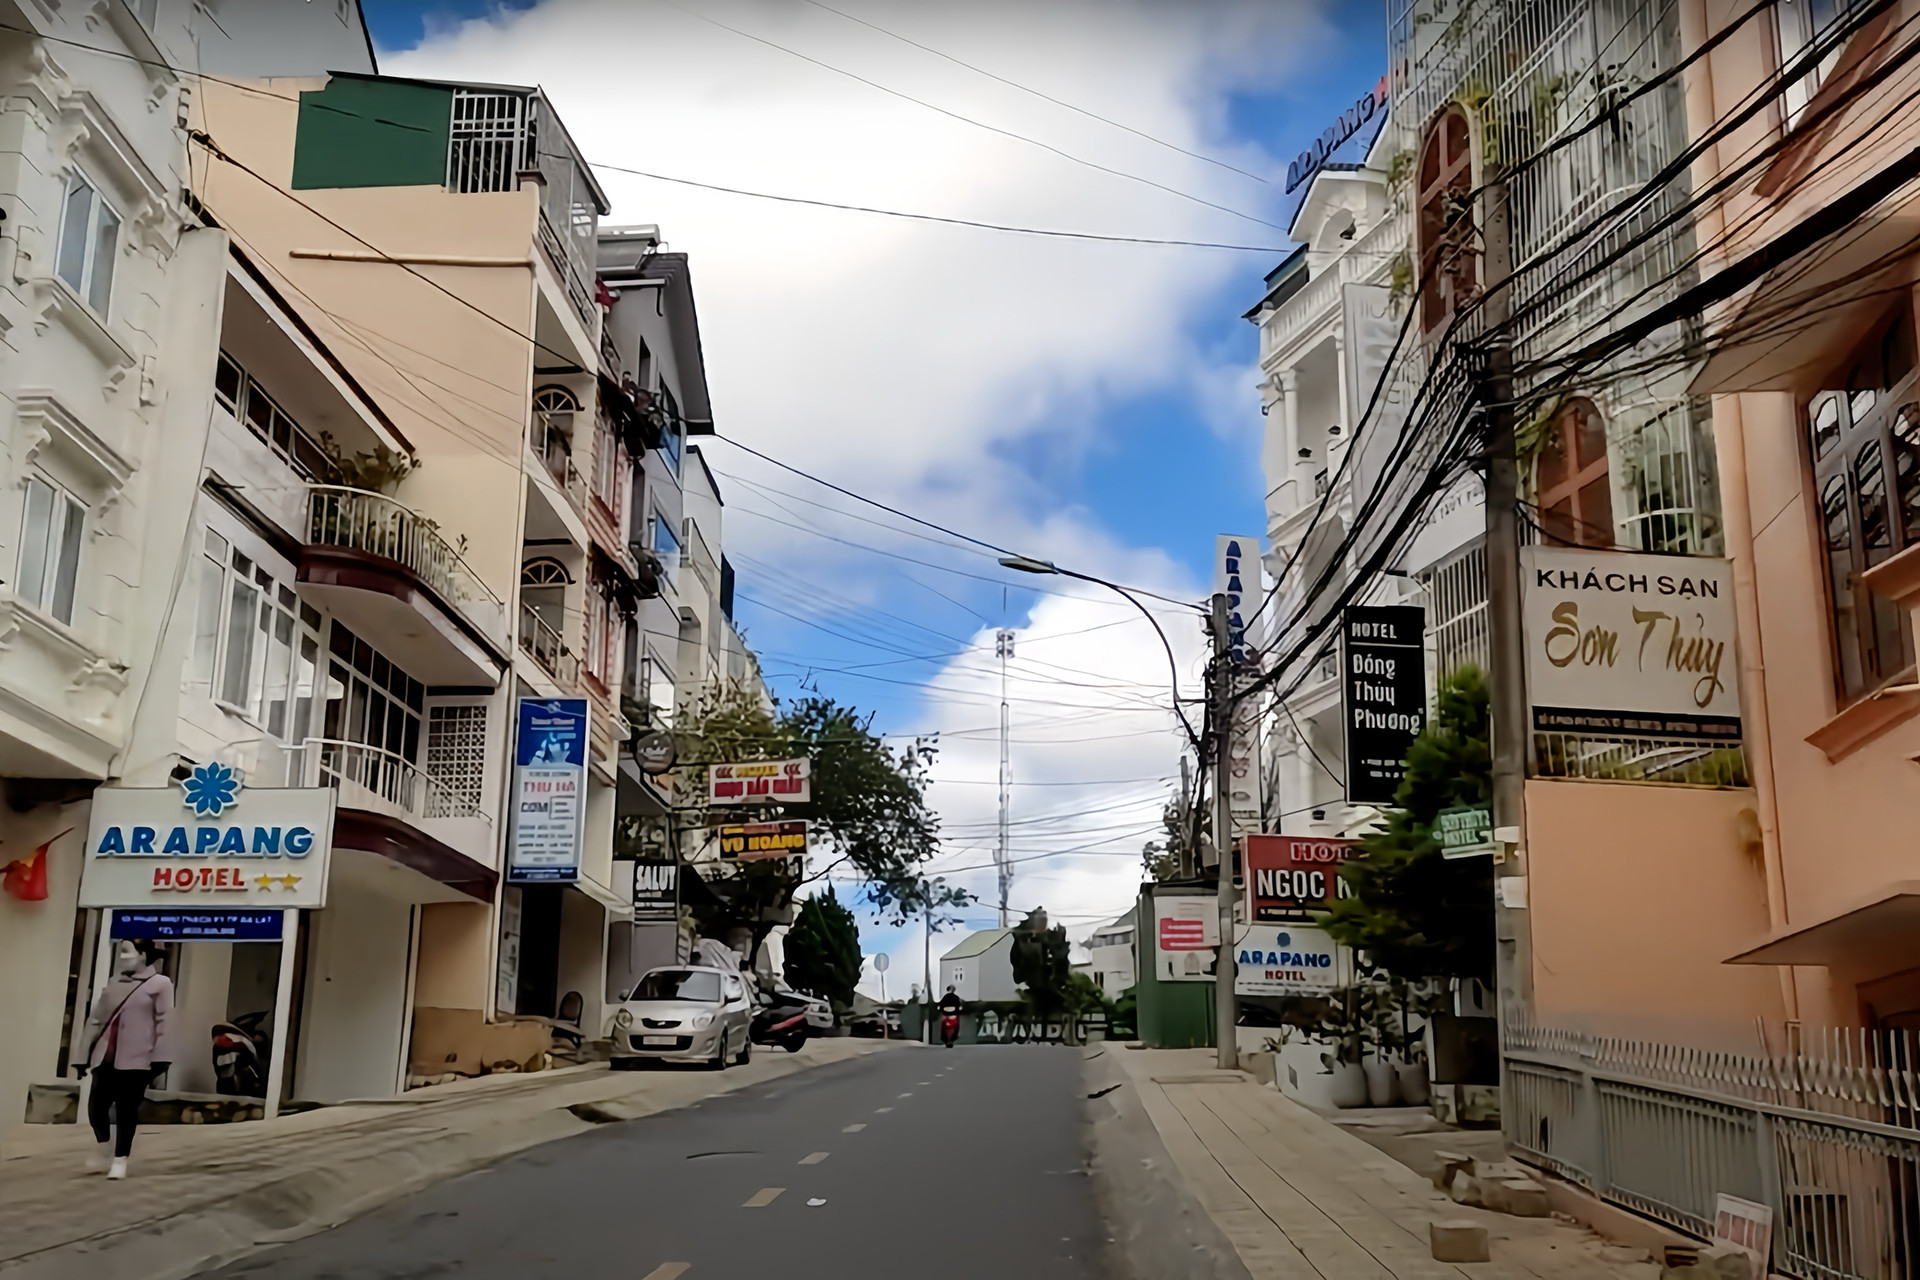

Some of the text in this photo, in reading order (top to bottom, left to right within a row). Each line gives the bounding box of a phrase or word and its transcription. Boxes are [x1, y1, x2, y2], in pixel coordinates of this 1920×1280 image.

[1537, 567, 1718, 600] KHÁCH SẠN
[1352, 622, 1397, 639] HOTEL
[97, 826, 315, 858] ARAPANG
[153, 867, 246, 889] HOTEL
[1257, 868, 1325, 904] NGỌC
[1238, 950, 1331, 968] ARAPANG
